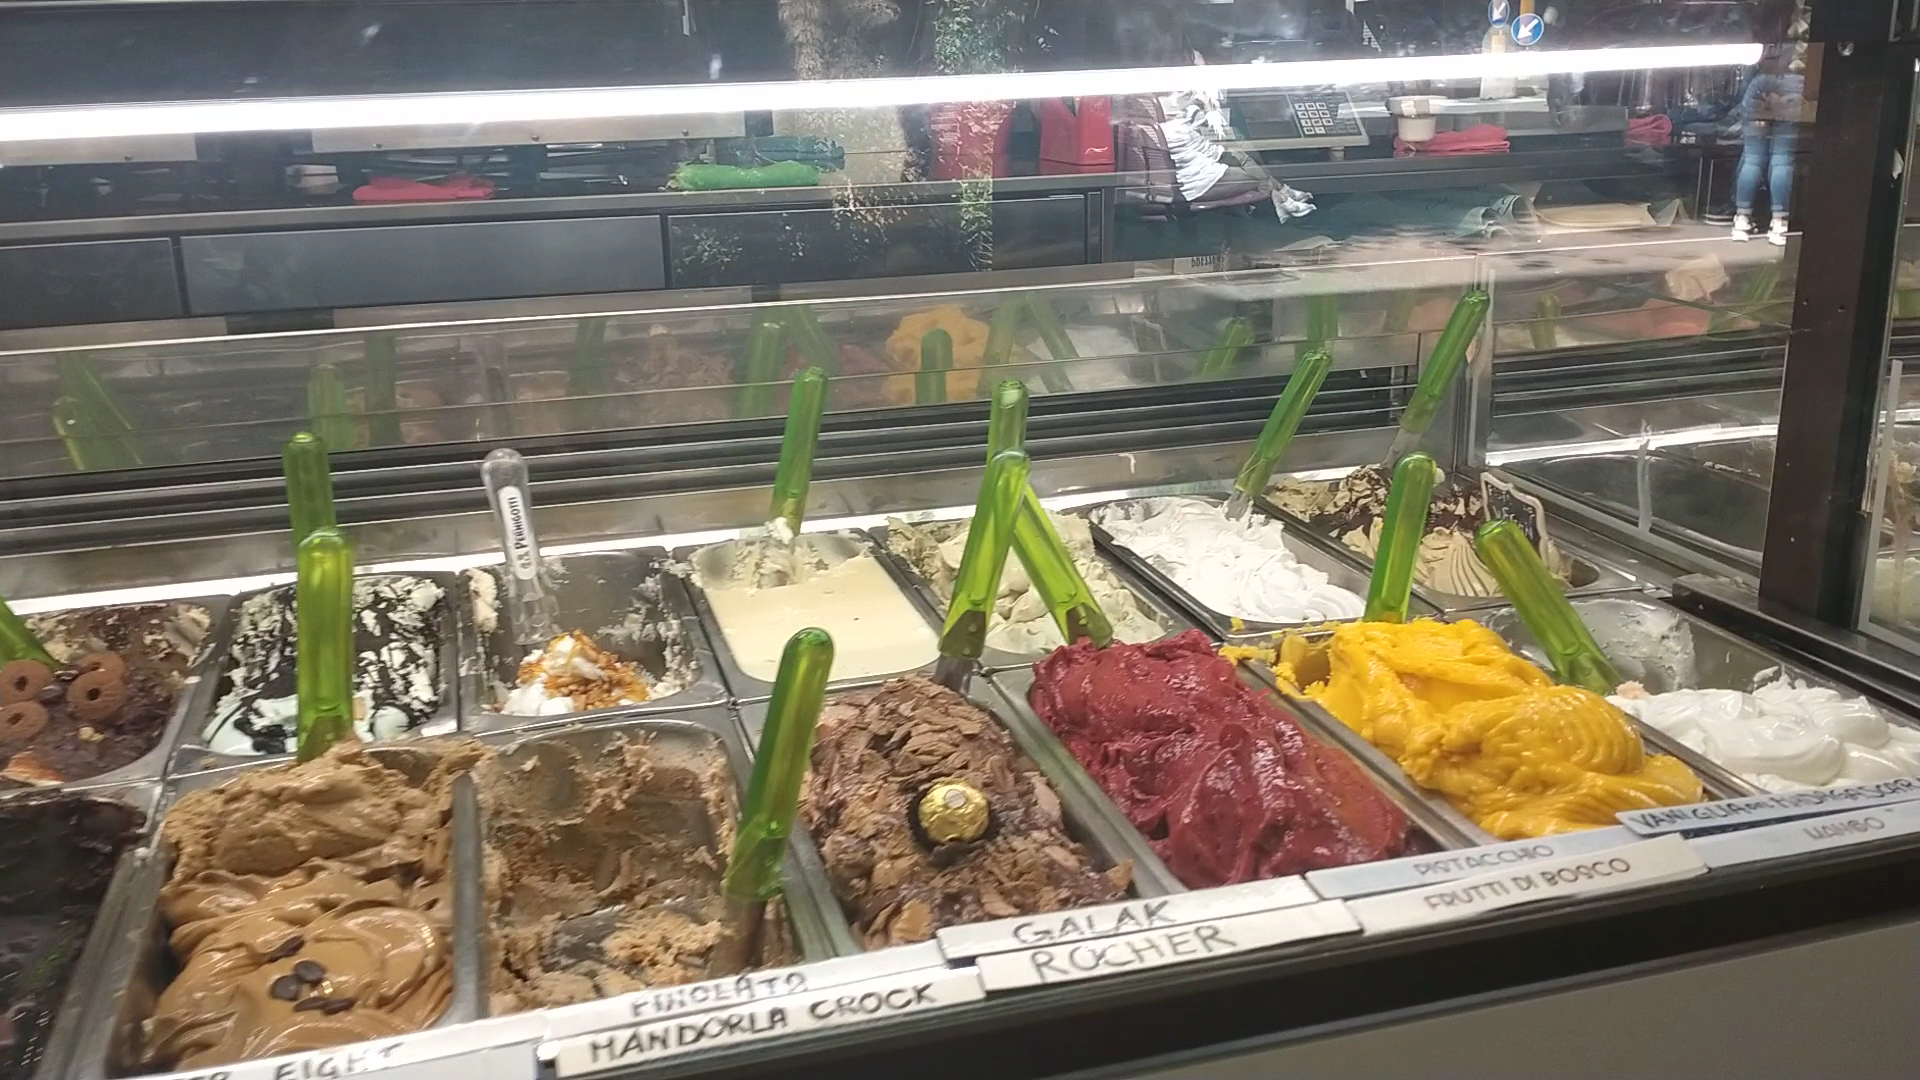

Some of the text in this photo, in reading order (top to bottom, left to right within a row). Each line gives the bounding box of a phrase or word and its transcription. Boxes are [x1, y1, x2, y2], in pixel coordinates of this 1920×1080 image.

[1412, 844, 1555, 876] PISTACCHIO
[1423, 857, 1632, 911] FRUTTI DI BOSCO
[1011, 900, 1179, 945] GALAK
[1030, 925, 1237, 983] ROCHER
[590, 982, 938, 1064] MANDORLA CROCK
[273, 1041, 405, 1080] EIGHT
